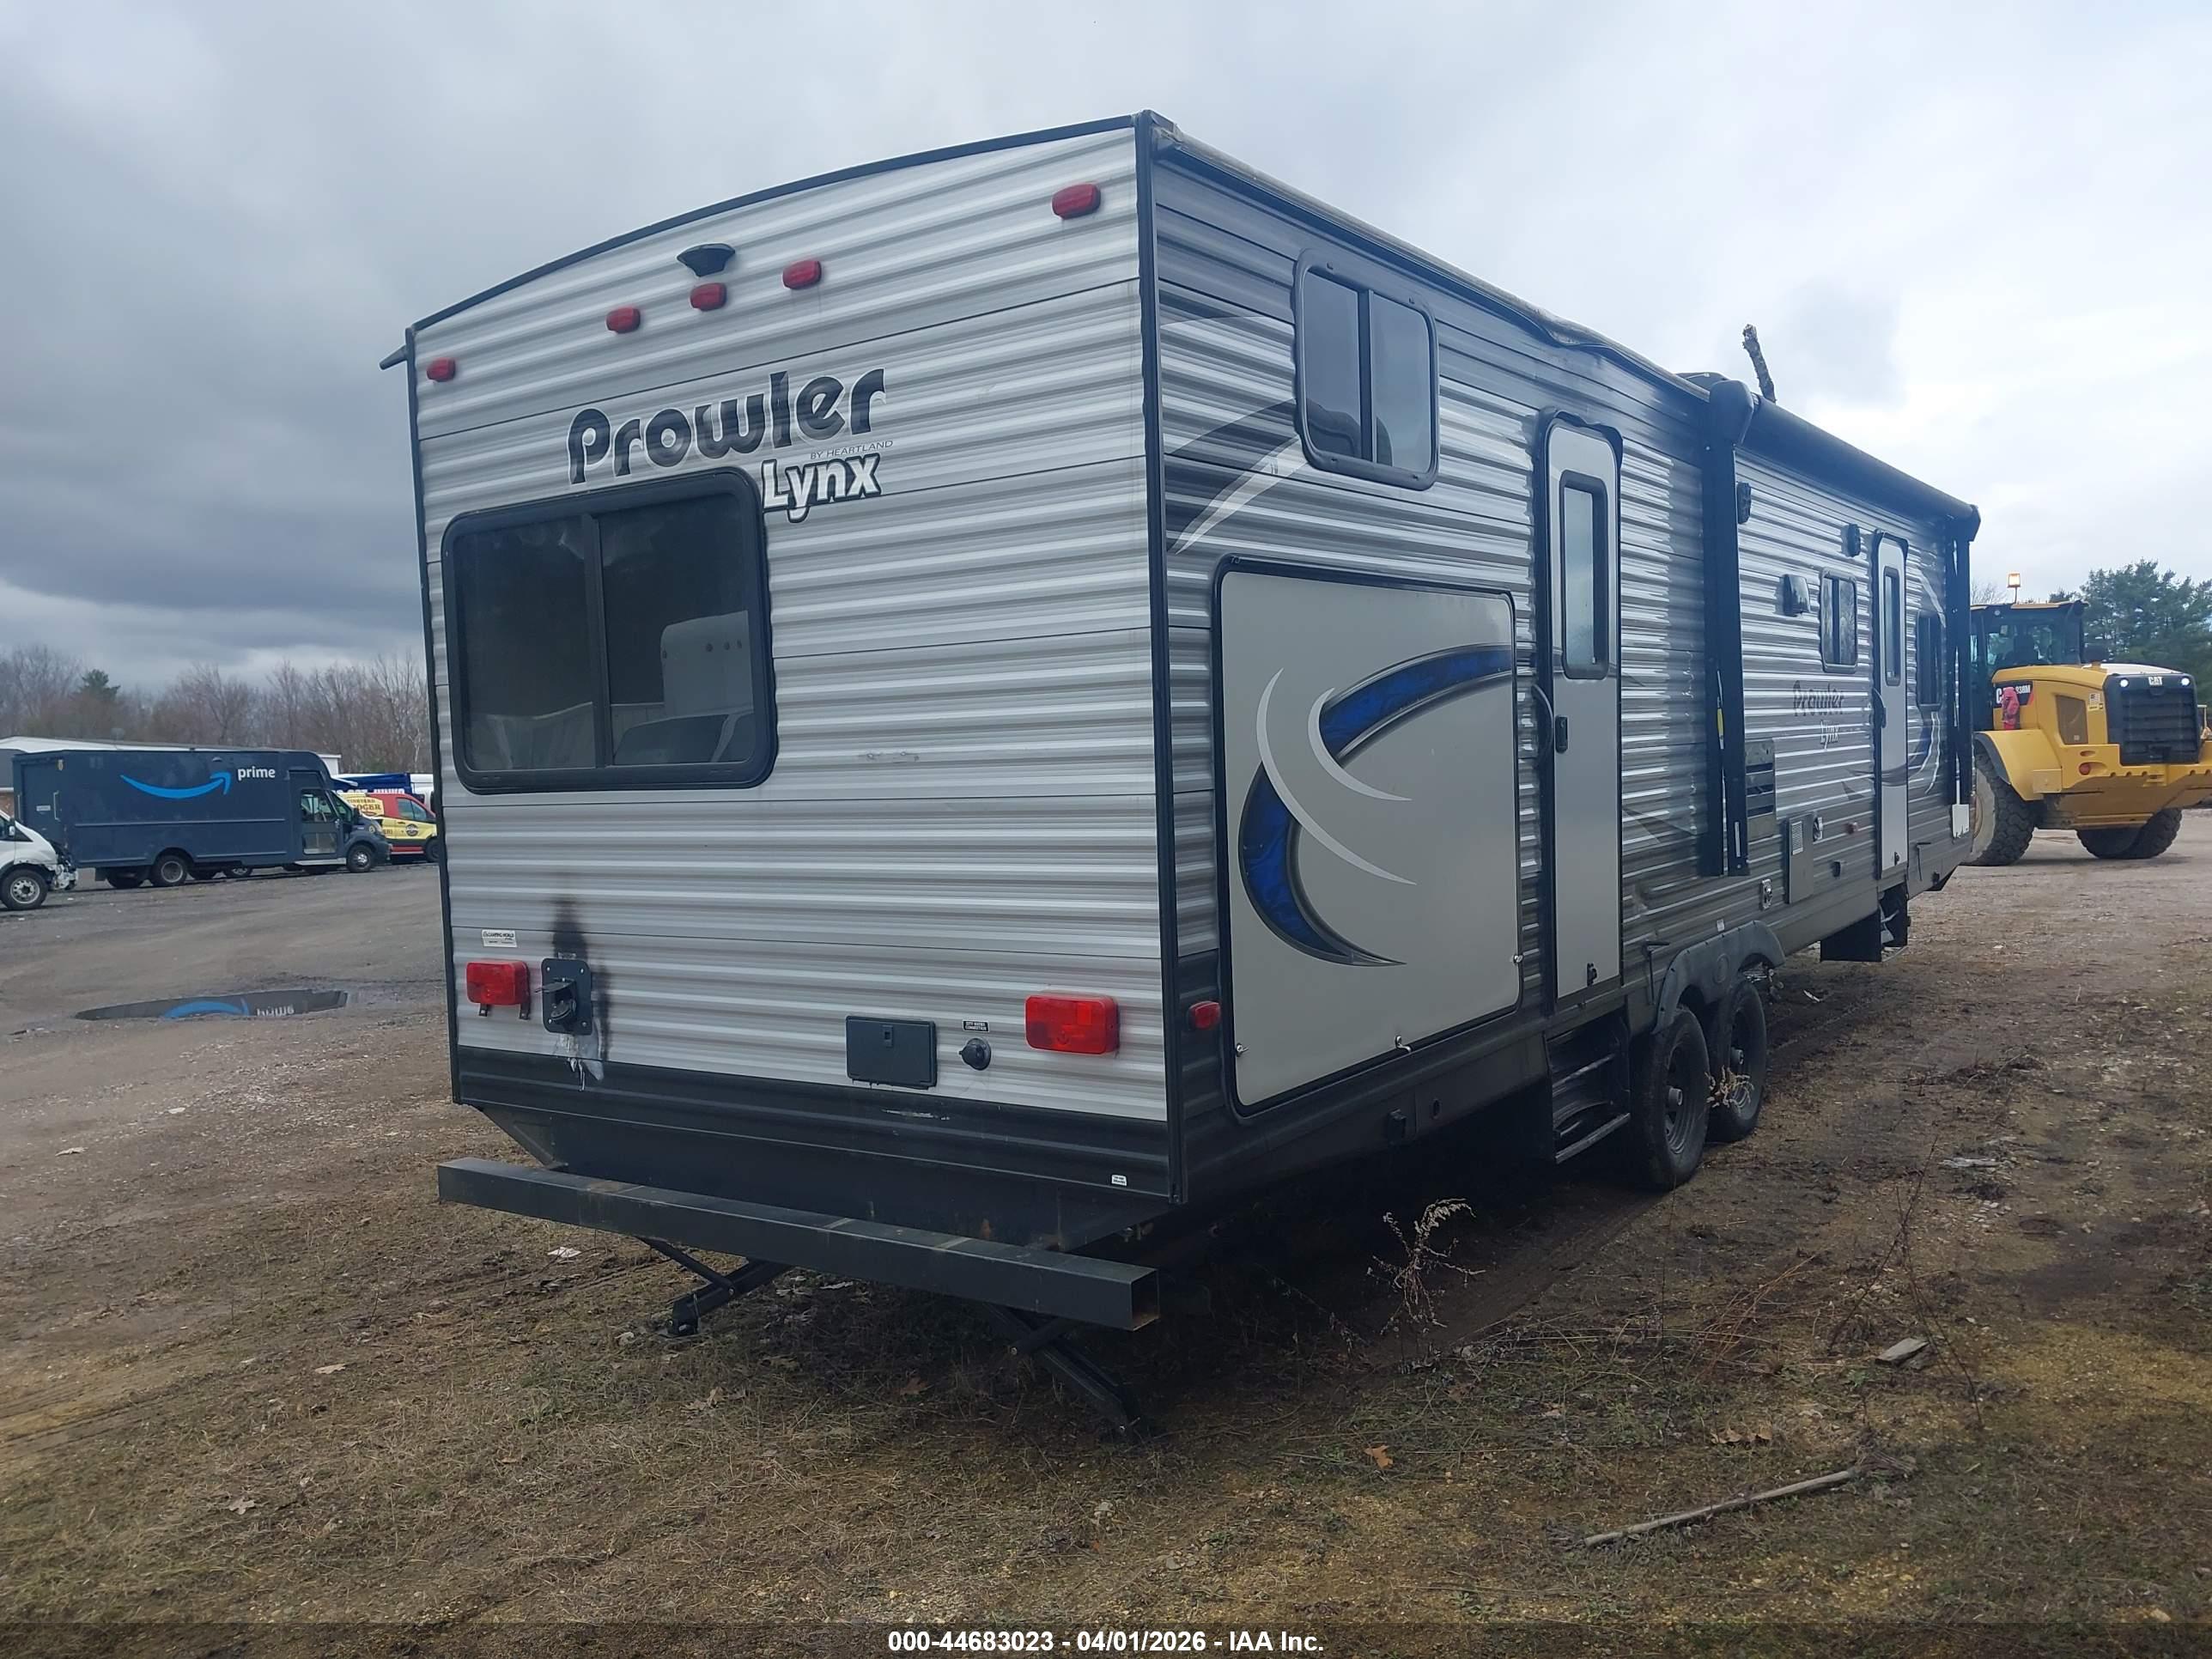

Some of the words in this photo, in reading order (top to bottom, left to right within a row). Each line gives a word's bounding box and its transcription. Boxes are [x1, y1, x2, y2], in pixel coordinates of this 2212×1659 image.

[567, 368, 886, 485] Prowler
[810, 451, 824, 459] BY
[826, 440, 894, 459] HEARTLAND
[762, 453, 882, 523] Lynx
[2148, 676, 2163, 685] CAT
[1793, 680, 1844, 716] Prowler
[1820, 720, 1839, 751] Lynx
[238, 766, 276, 781] prime
